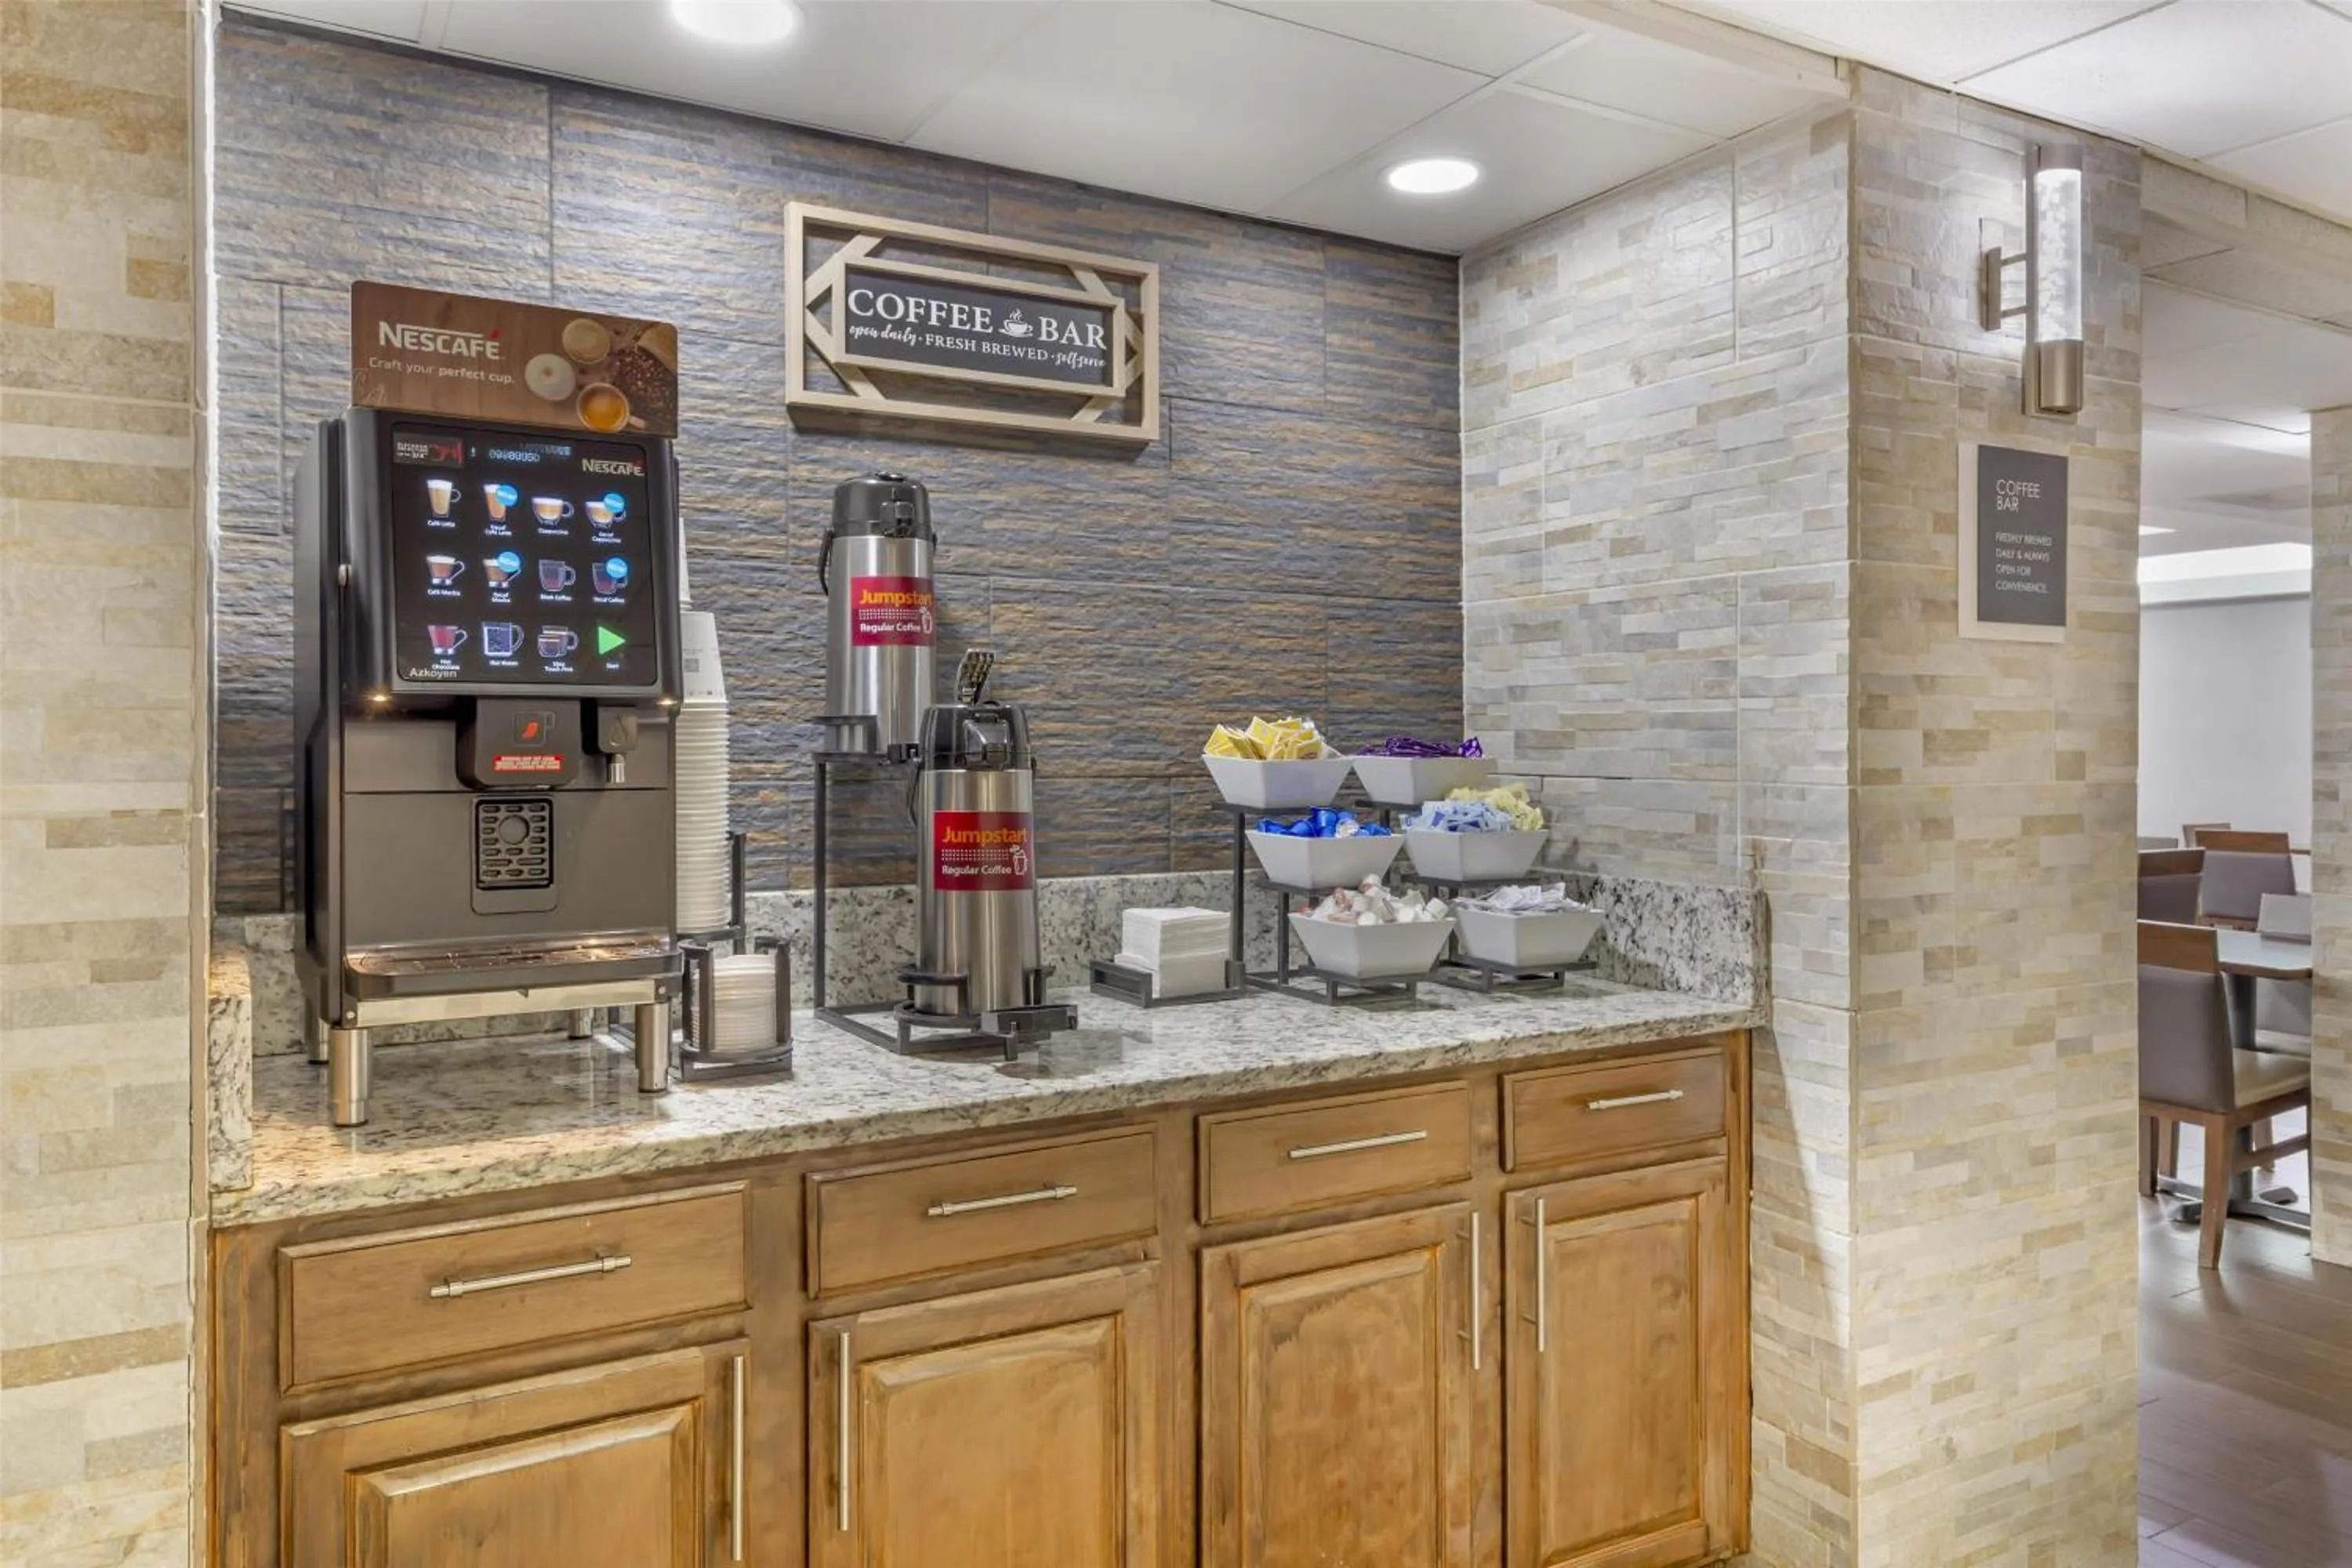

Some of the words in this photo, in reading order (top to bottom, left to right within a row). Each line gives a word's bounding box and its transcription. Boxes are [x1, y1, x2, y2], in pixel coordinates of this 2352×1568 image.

[848, 289, 993, 333] COFFEE
[1037, 316, 1107, 350] BAR
[880, 323, 916, 347] daily
[925, 333, 976, 352] FRESH
[982, 341, 1049, 361] BREWED
[369, 357, 402, 372] Craft
[406, 362, 434, 376] your
[438, 365, 485, 382] perfect
[1995, 479, 2040, 499] COFFEE
[1997, 495, 2019, 514] BAR
[860, 622, 894, 633] Regular
[896, 622, 920, 632] Coffee
[409, 668, 457, 680] Azkoyen
[942, 826, 1027, 847] Jumpstart
[942, 865, 978, 877] Regular
[981, 865, 1012, 876] Coffee
